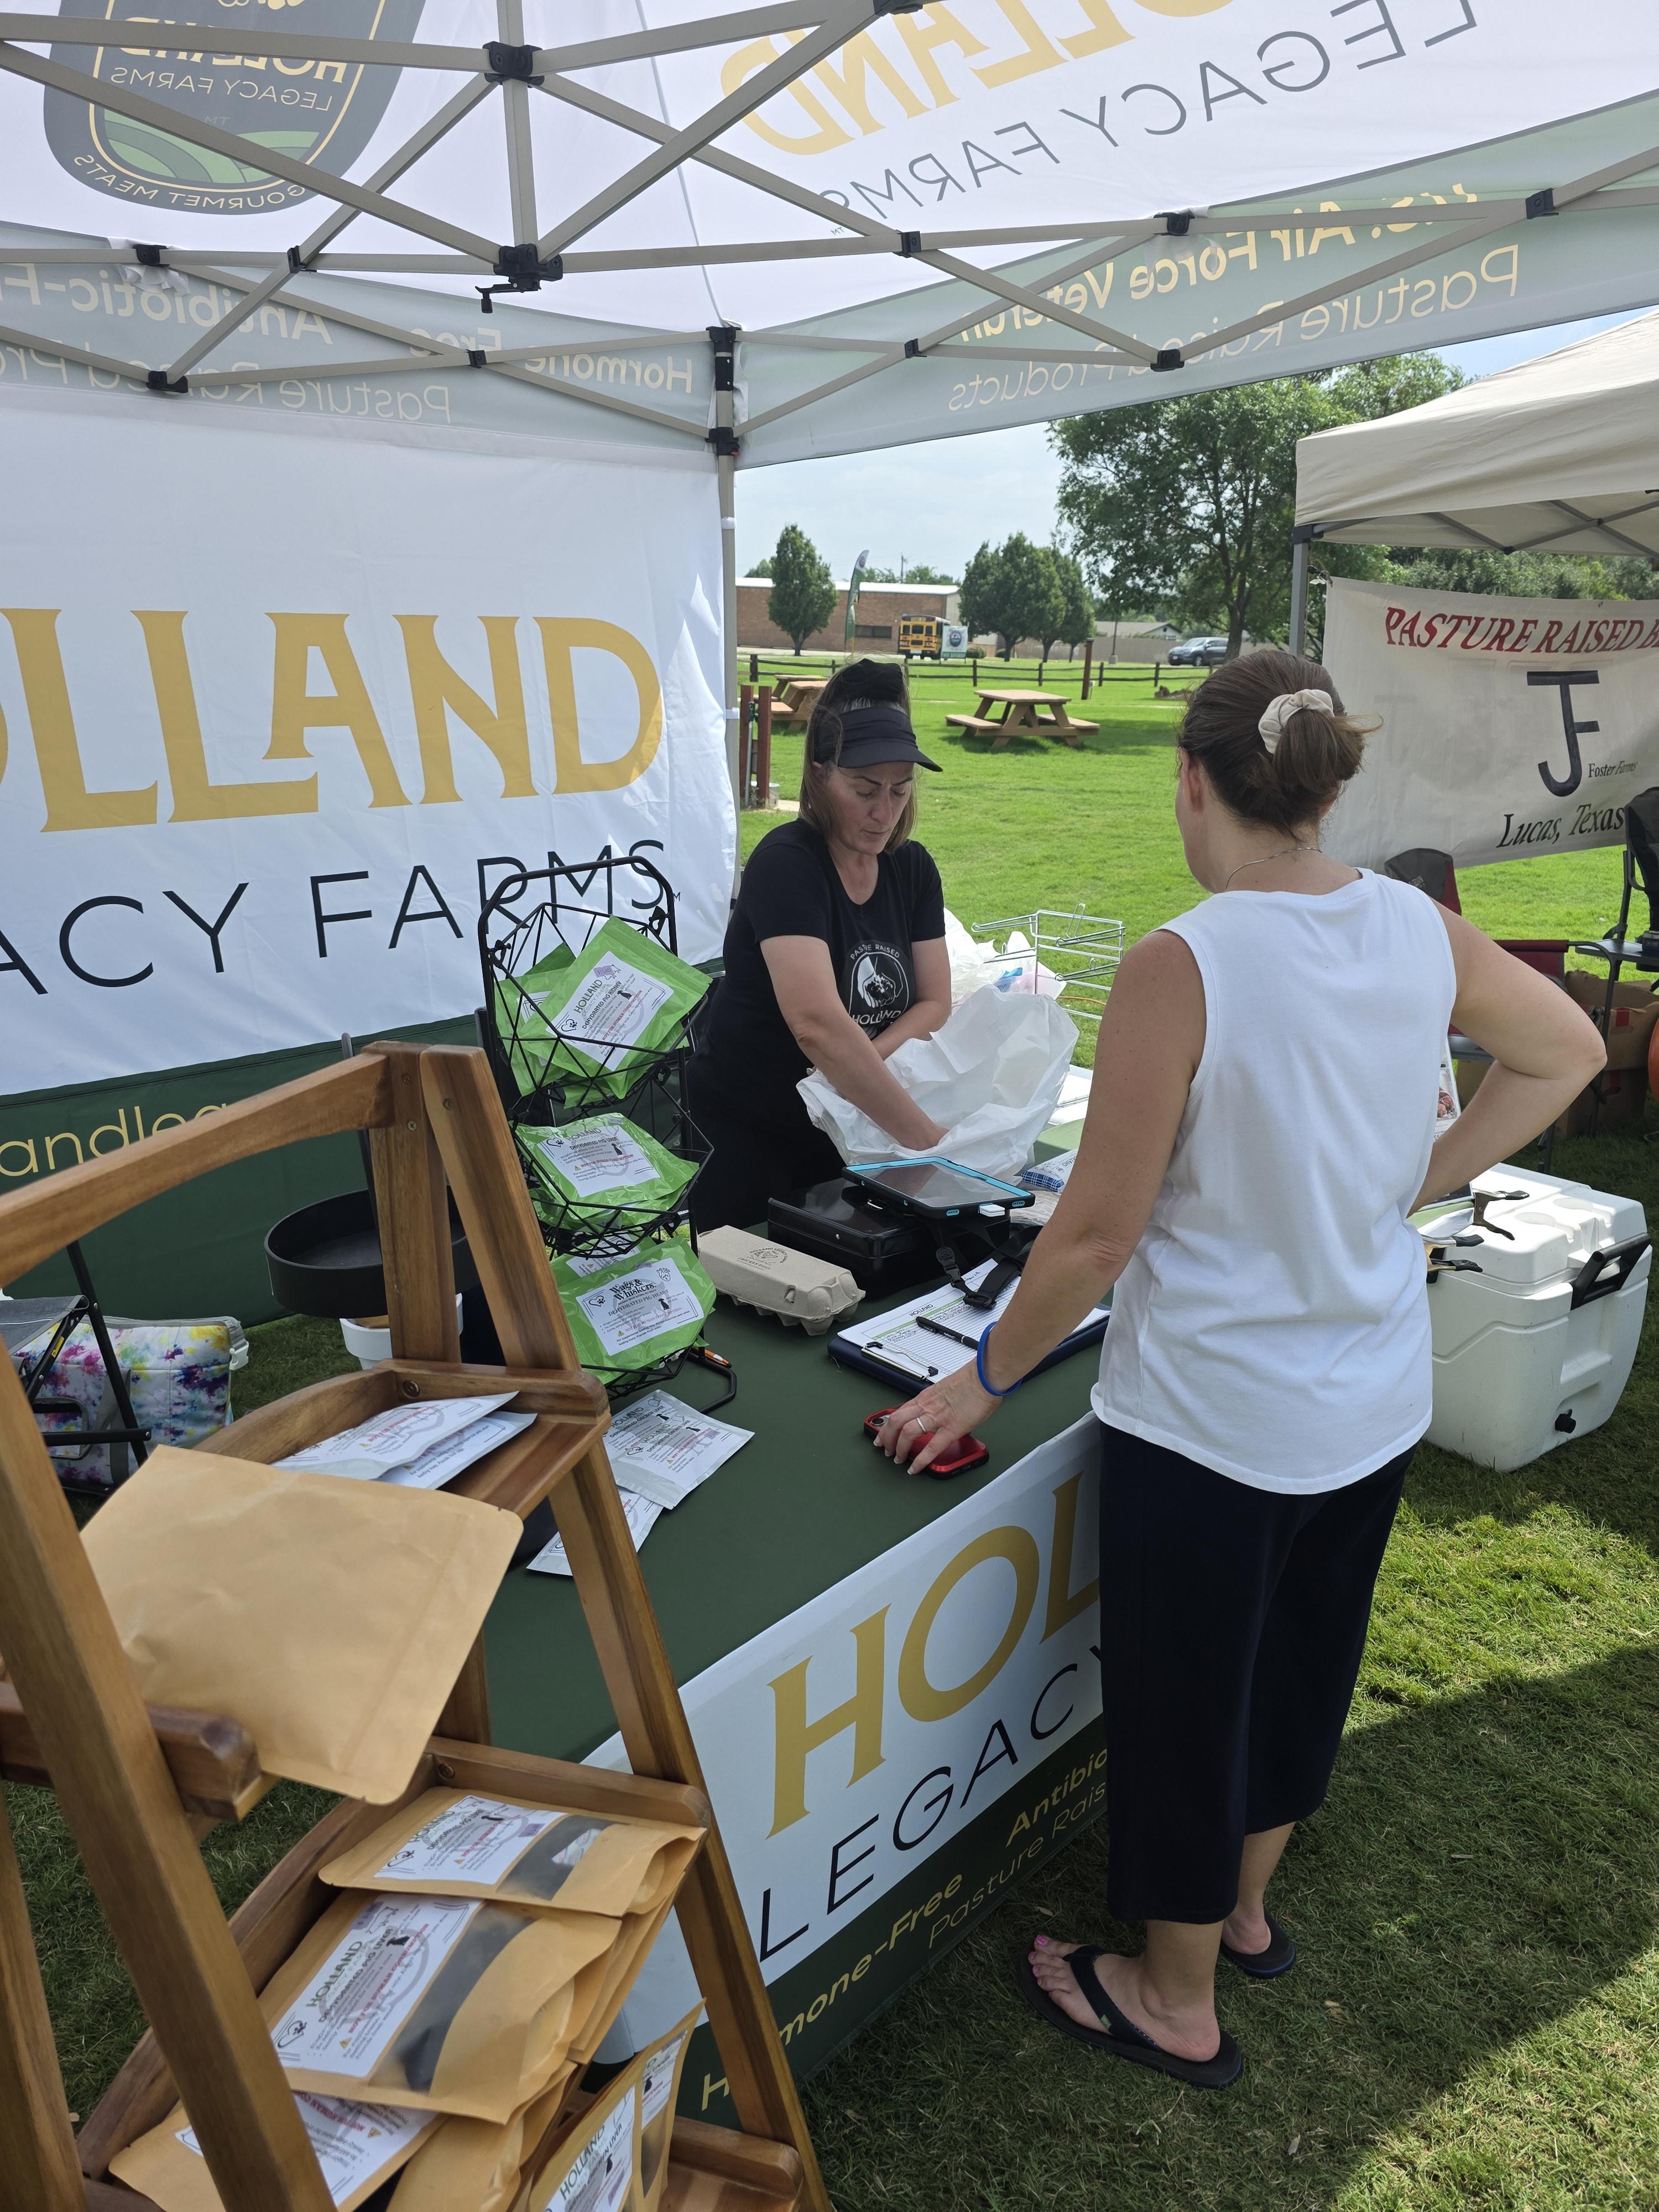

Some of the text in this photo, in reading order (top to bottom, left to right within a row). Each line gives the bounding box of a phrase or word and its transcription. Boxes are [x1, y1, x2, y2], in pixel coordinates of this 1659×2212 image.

[1385, 606, 1538, 653] PASTURE
[1532, 619, 1645, 653] RAISED
[0, 608, 662, 833] LLAND
[1588, 761, 1615, 778] Foster
[1496, 804, 1625, 848] Lucas, Texas
[310, 839, 664, 958] FARMS
[573, 978, 603, 1013] HOLLAND
[582, 980, 622, 1029] DEHYDRATED PIG KIDNEY
[613, 1281, 655, 1301] Whiskers
[633, 1277, 643, 1287] &
[651, 1288, 669, 1298] HEART
[909, 1303, 933, 1317] HOLLAND
[611, 1405, 644, 1428] HOLLAND
[759, 1645, 1102, 1963] LEGAC
[1005, 1747, 1108, 1848] Antibio
[928, 1781, 1106, 1949] Pasture Rais
[362, 1948, 378, 1966] PIG
[374, 1928, 393, 1948] LIVER
[306, 1940, 363, 2006] HOLLAND
[347, 1923, 429, 2033] NOT FOR HUMAN CONSUMPTION
[609, 2123, 623, 2148] LIVER
[560, 2124, 605, 2201] HOLLAND
